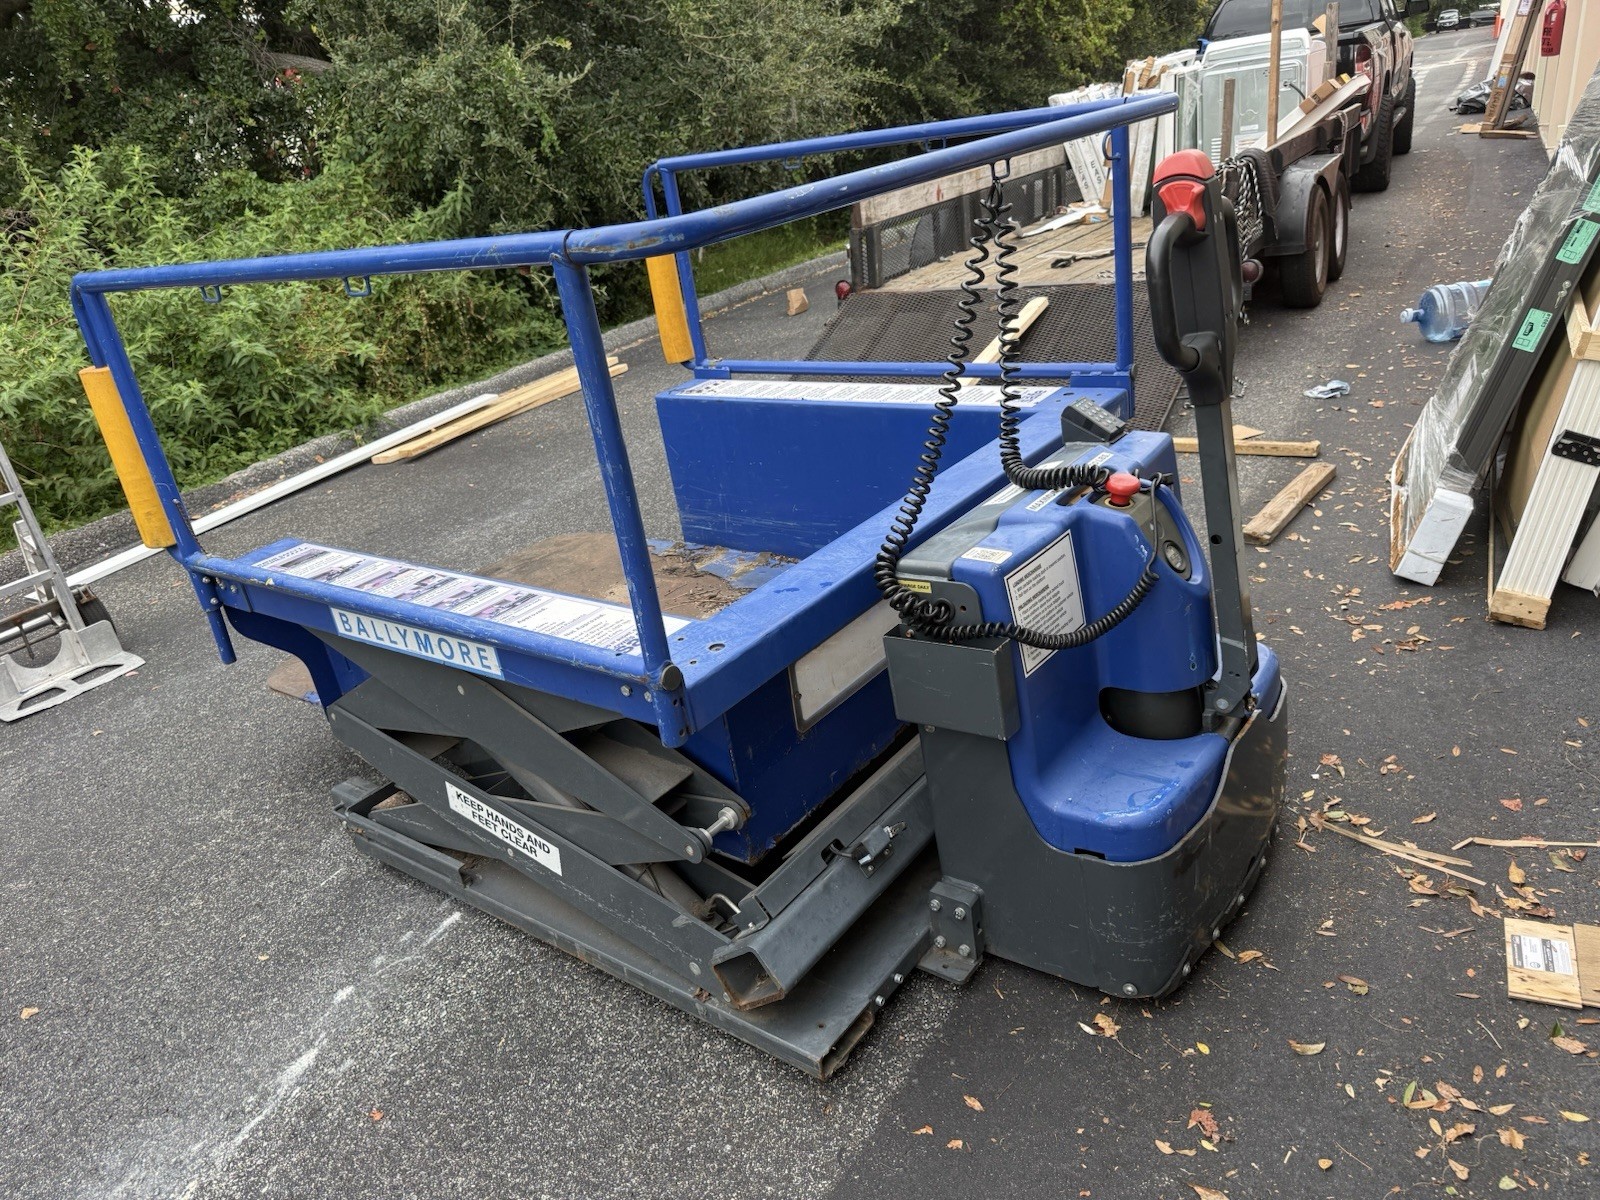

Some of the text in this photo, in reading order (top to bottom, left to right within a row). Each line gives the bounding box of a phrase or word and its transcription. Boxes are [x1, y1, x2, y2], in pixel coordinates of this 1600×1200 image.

[338, 612, 492, 670] BALLYMORE
[455, 791, 551, 854] KEEP HANDS AND
[471, 811, 537, 857] FEET CLEAR
